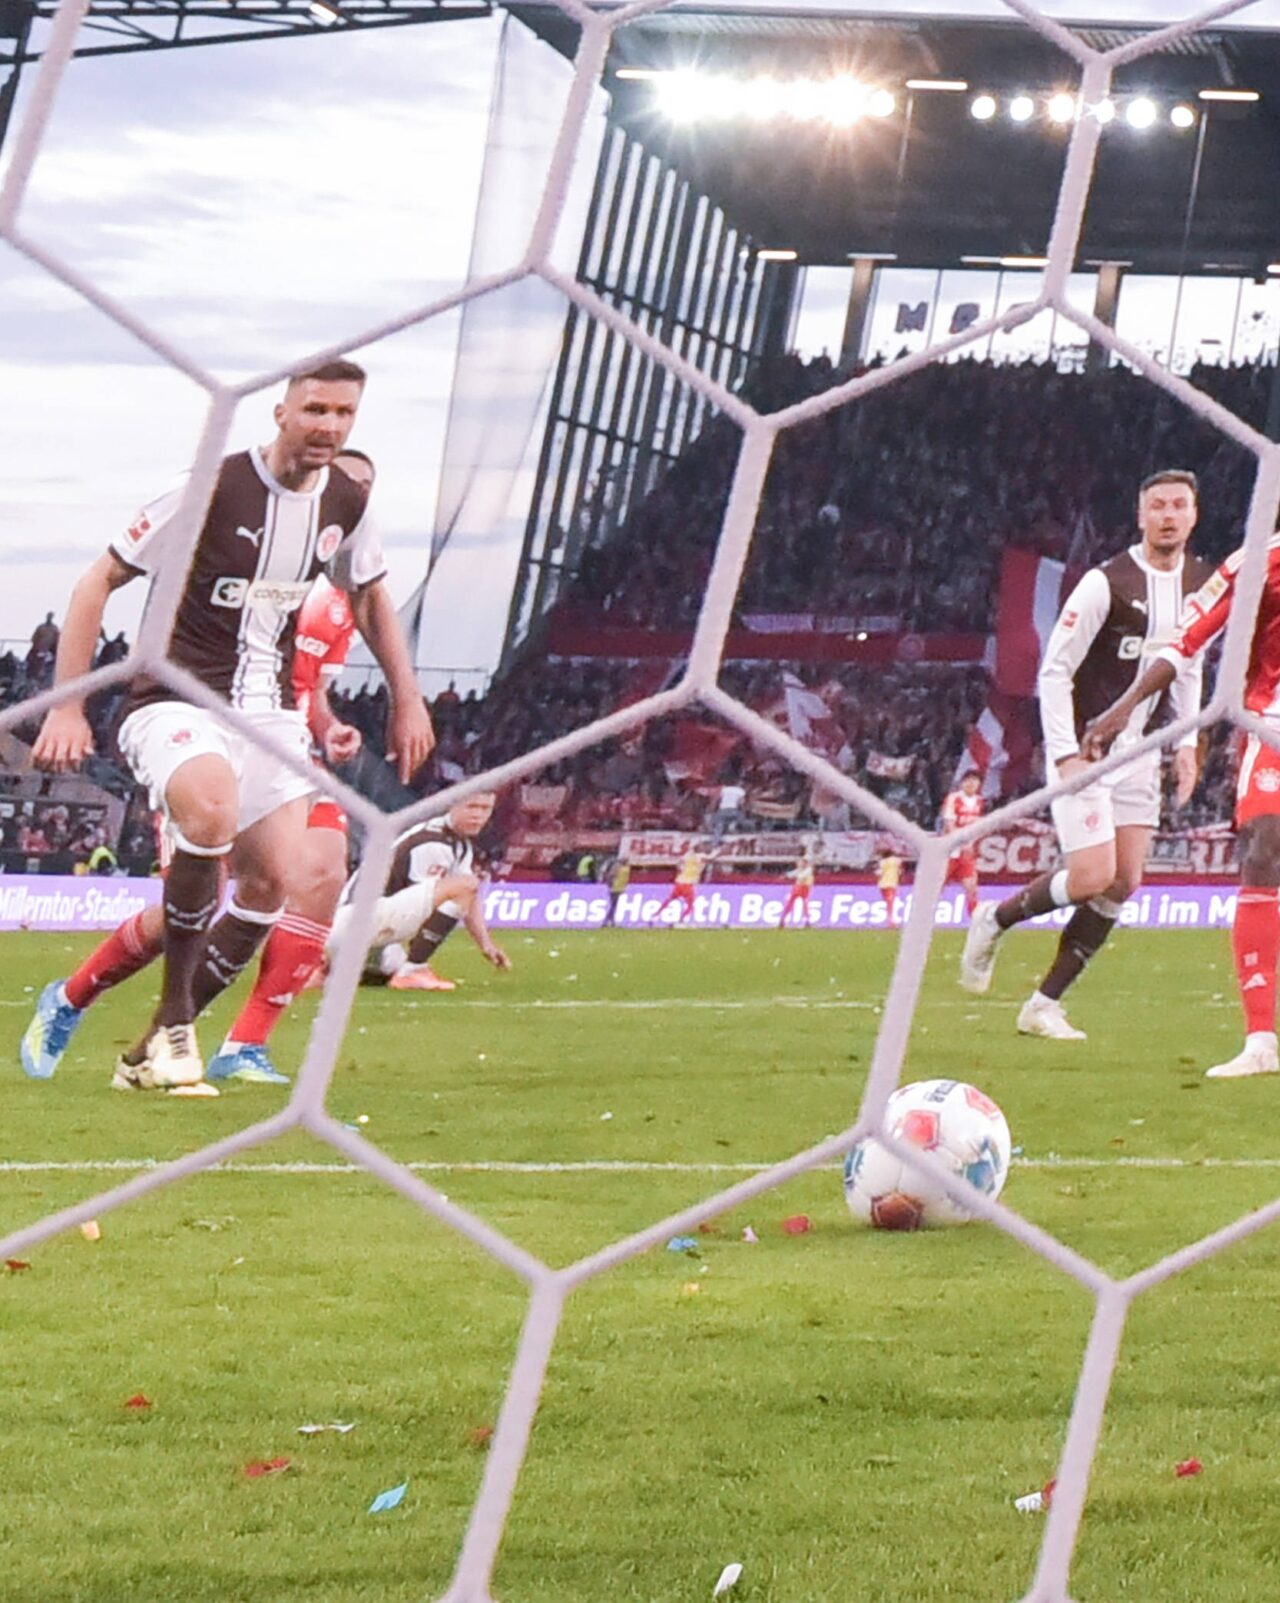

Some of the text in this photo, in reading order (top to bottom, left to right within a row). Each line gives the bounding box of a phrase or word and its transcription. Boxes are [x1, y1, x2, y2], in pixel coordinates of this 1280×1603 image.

[484, 889, 539, 921] für
[545, 892, 608, 922] das
[830, 893, 965, 924] Festial
[1158, 894, 1199, 924] im
